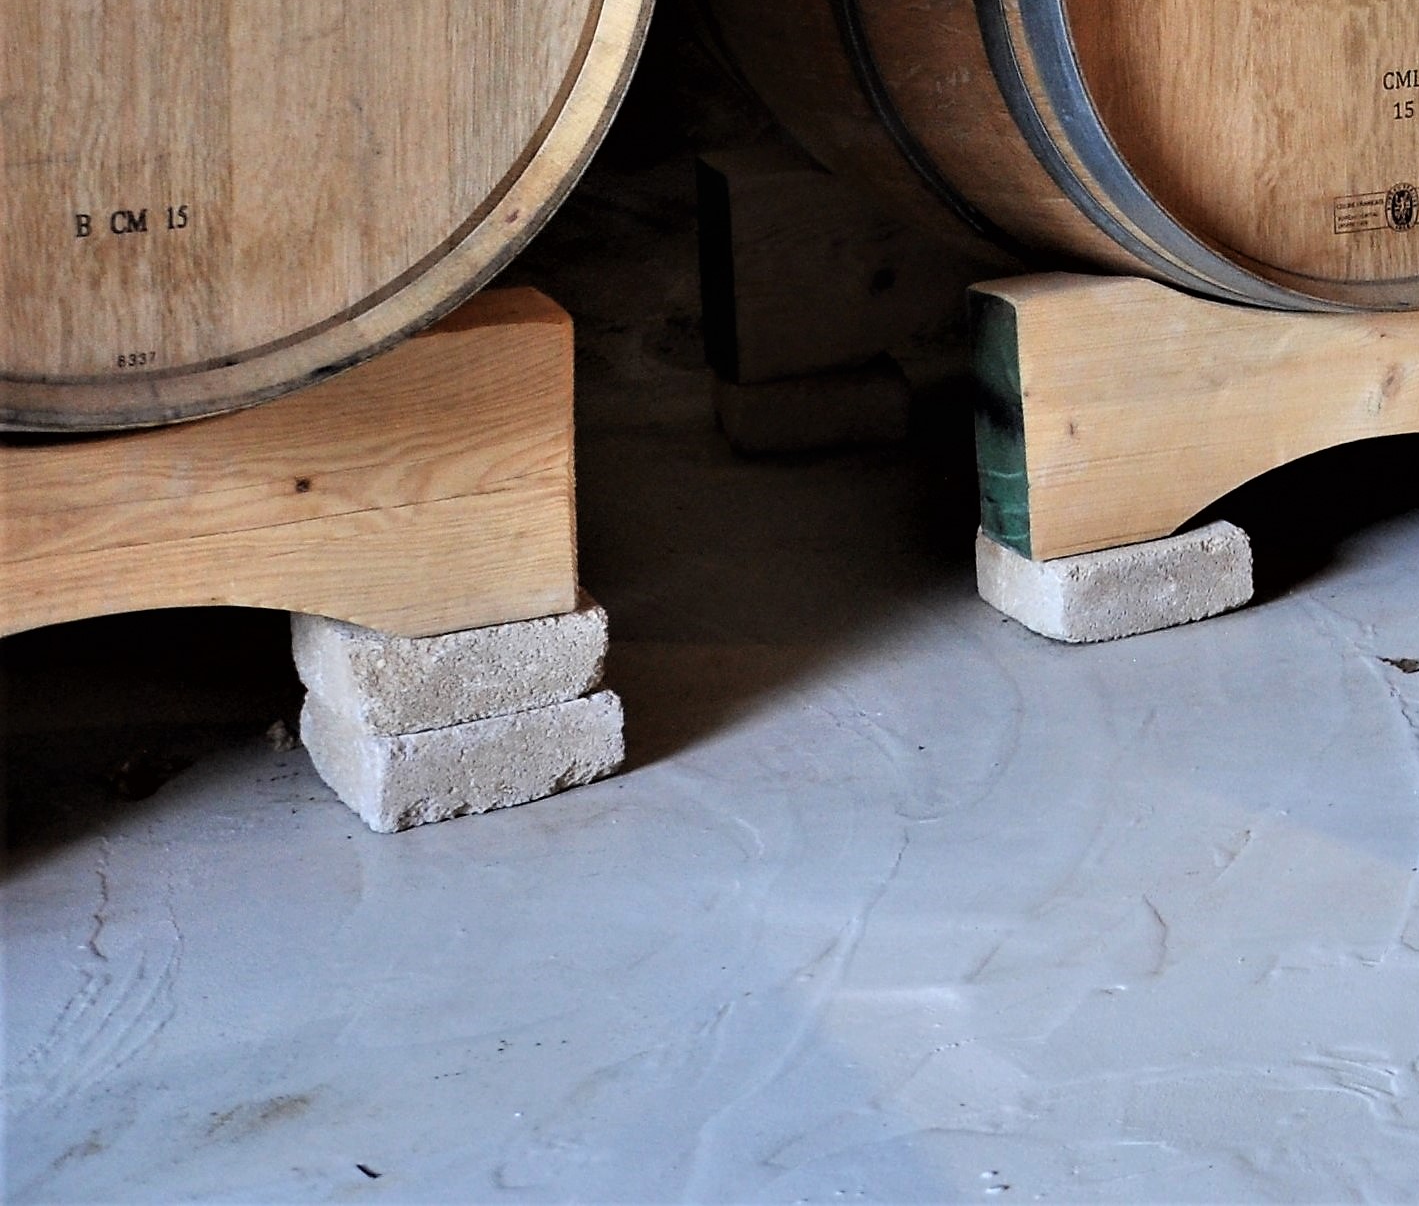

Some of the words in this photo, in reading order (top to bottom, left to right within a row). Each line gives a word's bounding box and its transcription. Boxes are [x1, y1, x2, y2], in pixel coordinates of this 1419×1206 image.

[1393, 101, 1414, 120] 15
[76, 214, 92, 237] B
[110, 209, 148, 234] CM
[167, 205, 188, 229] 15
